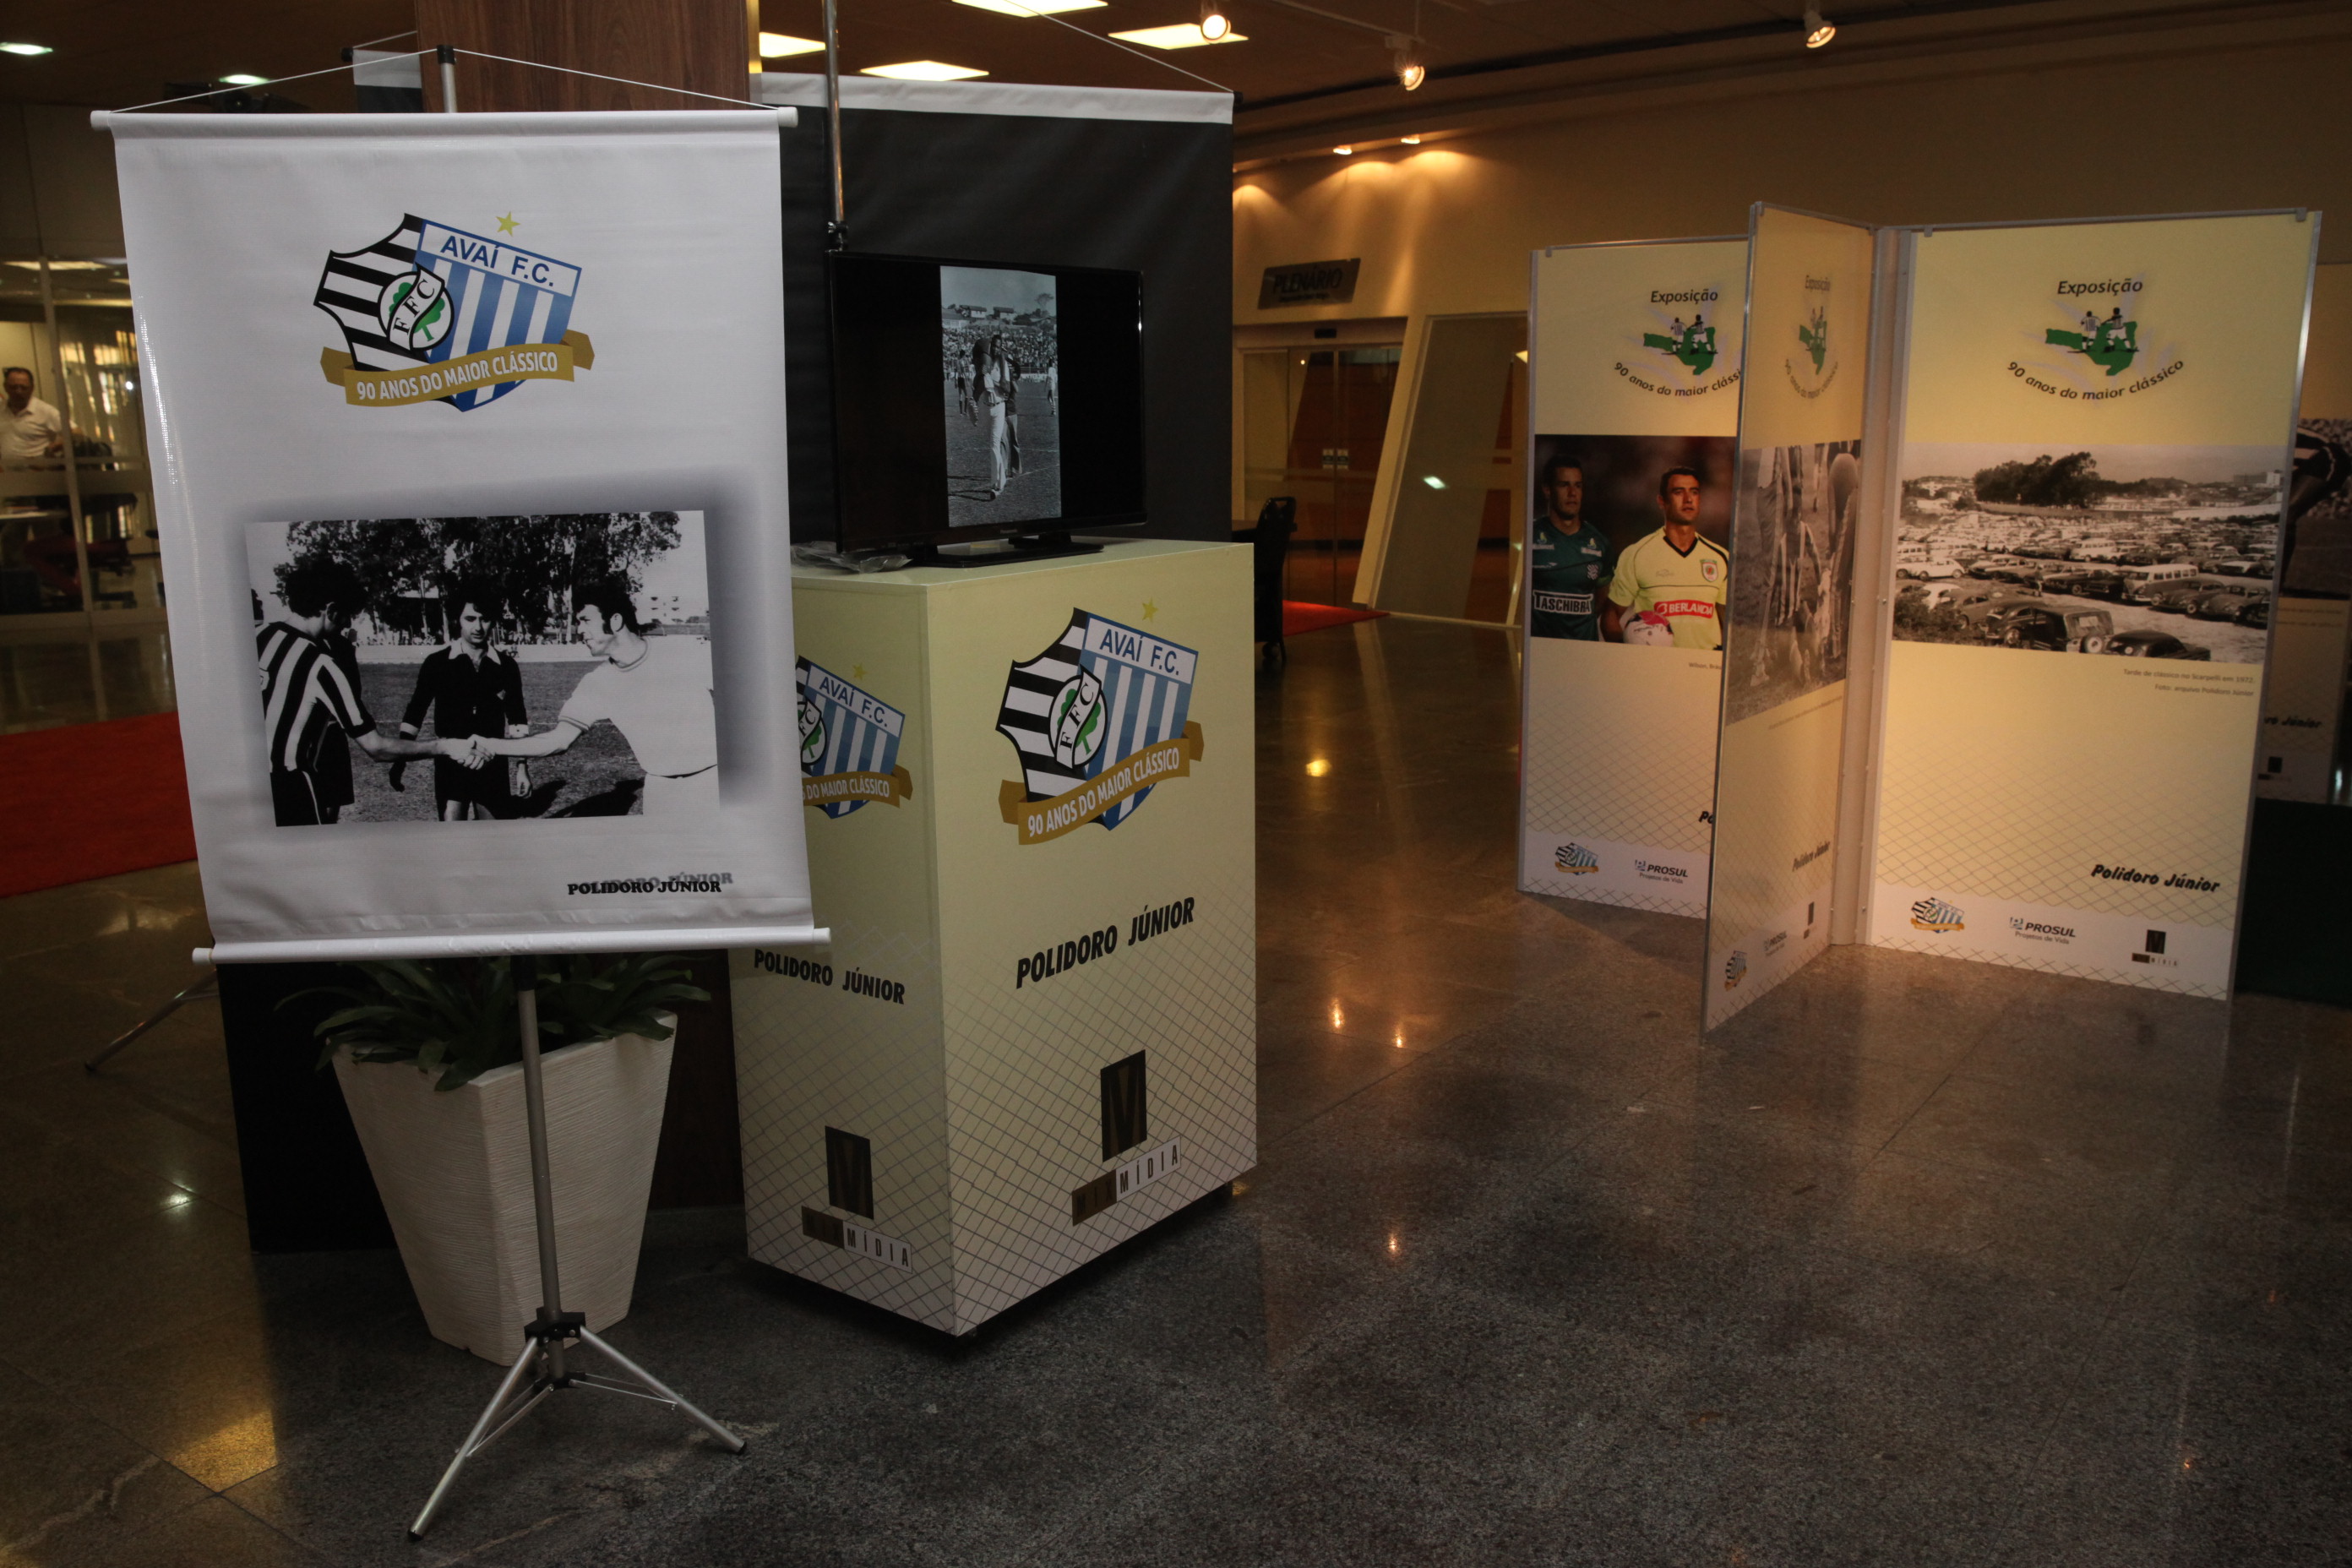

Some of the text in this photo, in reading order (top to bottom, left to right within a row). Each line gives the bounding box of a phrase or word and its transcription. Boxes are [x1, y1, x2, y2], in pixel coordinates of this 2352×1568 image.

[440, 235, 555, 287] AVAÍ F.C.
[1651, 288, 1718, 305] Exposição
[2057, 278, 2143, 297] Exposição
[357, 350, 558, 401] 90 ANOS DO MAIOR CLÁSSICO
[1614, 362, 1741, 397] 90 anos do maior clássi
[2006, 360, 2184, 400] 90 anos do maior clássico
[1099, 629, 1180, 676] AVAÍ F.C.
[819, 676, 888, 727] AVAÍ F.C.
[807, 785, 820, 799] DO
[821, 779, 849, 798] MAIOR
[849, 775, 890, 798] CLÁSSICO
[1027, 747, 1180, 838] 90 ANOS DO MAIOR CLÁSSICO
[568, 879, 722, 896] POLIDORO JÚNIOR
[1647, 863, 1689, 878] PROSUL
[2090, 864, 2221, 893] Polidoro Júnior
[1016, 896, 1195, 990] POLIDORO JÚNIOR
[2015, 931, 2043, 940] Projetos
[2055, 936, 2070, 945] Vida
[2024, 922, 2077, 938] PROSUL
[754, 948, 906, 1005] POLIDORO JÚNIOR
[1119, 1144, 1179, 1194] MÍDIA
[847, 1227, 910, 1267] MÍDIA
